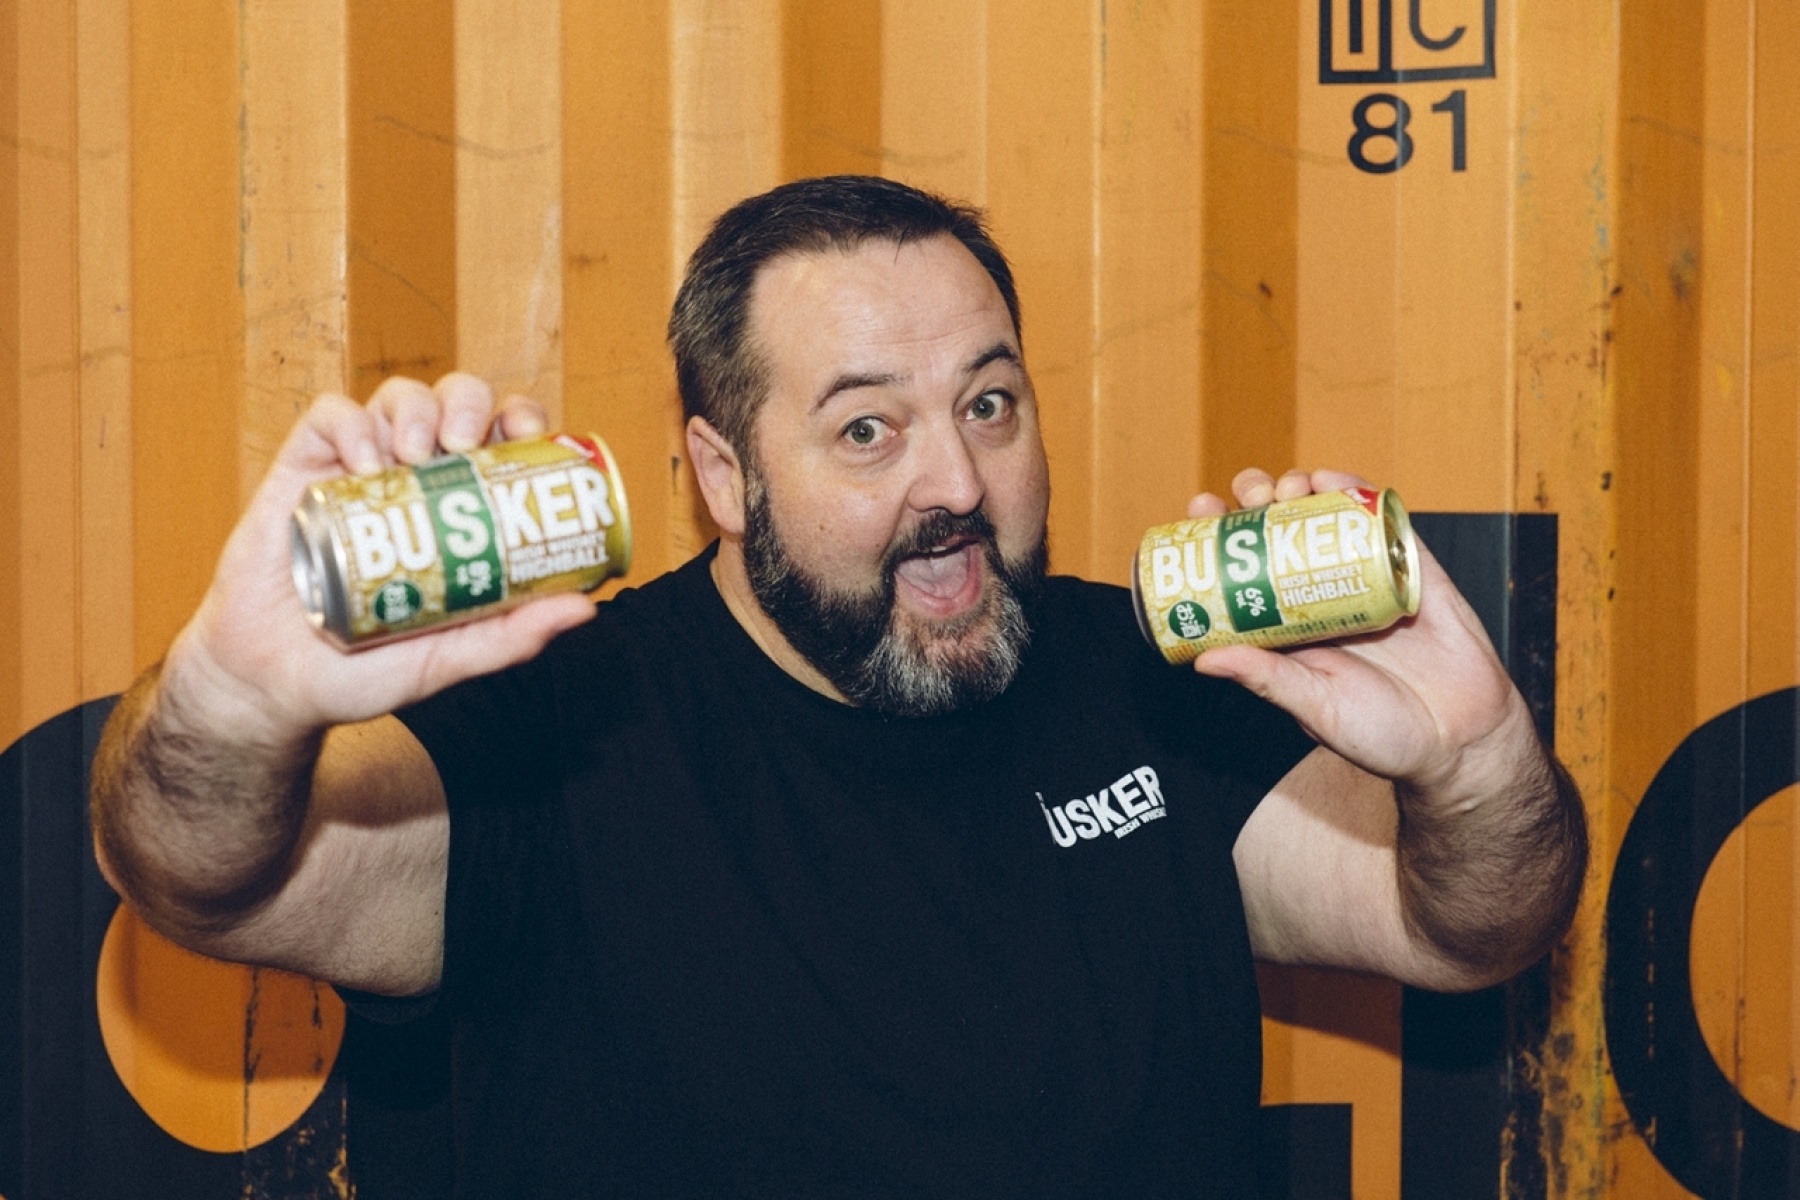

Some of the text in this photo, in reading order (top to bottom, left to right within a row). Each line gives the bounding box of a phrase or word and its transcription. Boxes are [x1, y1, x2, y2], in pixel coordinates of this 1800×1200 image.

[1347, 89, 1467, 174] 81
[347, 466, 615, 581] BUSKER
[1152, 510, 1375, 599] BUSKER
[1247, 588, 1267, 617] 6%
[1281, 579, 1371, 607] HIGHBALL
[1310, 565, 1363, 583] WHISKEY
[1041, 765, 1166, 848] USKER
